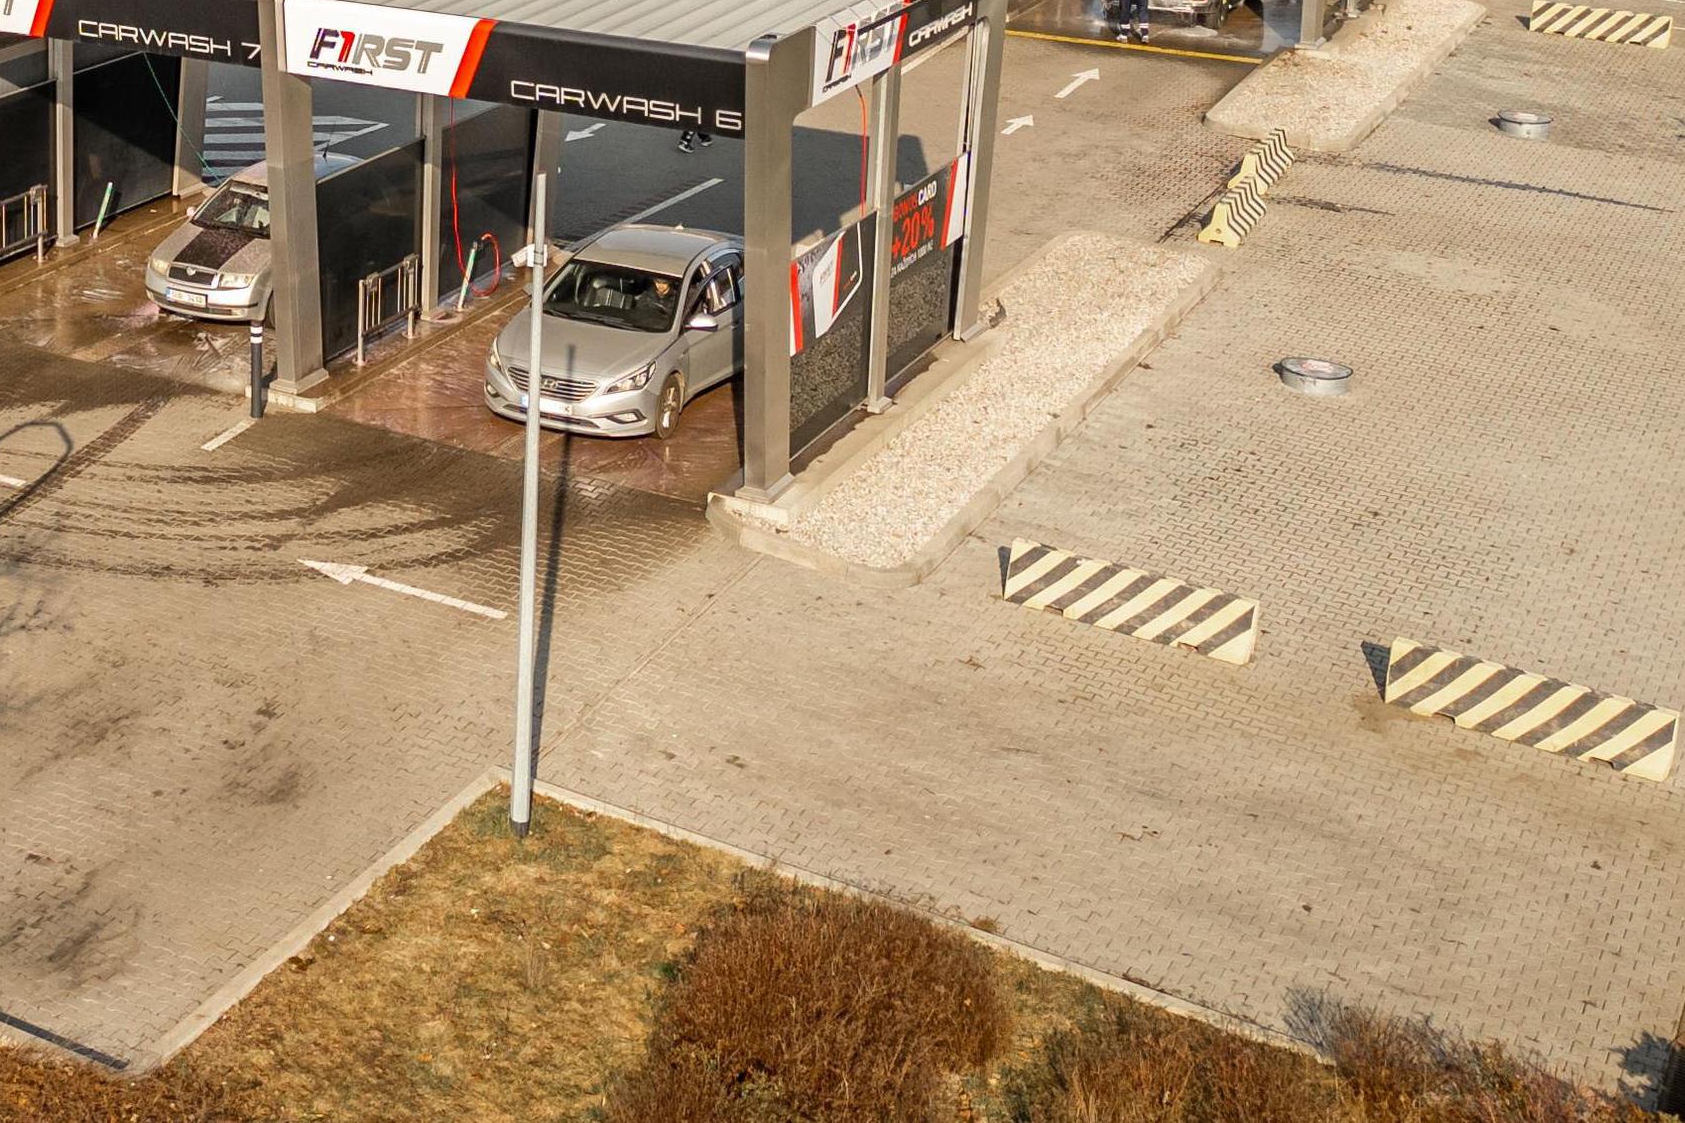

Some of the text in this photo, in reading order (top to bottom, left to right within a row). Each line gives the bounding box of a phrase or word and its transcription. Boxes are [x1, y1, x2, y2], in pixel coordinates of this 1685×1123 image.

[78, 19, 262, 59] CARWASH 7
[908, 1, 973, 48] CARWASH
[307, 60, 373, 76] CARWASH
[510, 79, 742, 130] CARWASH 6
